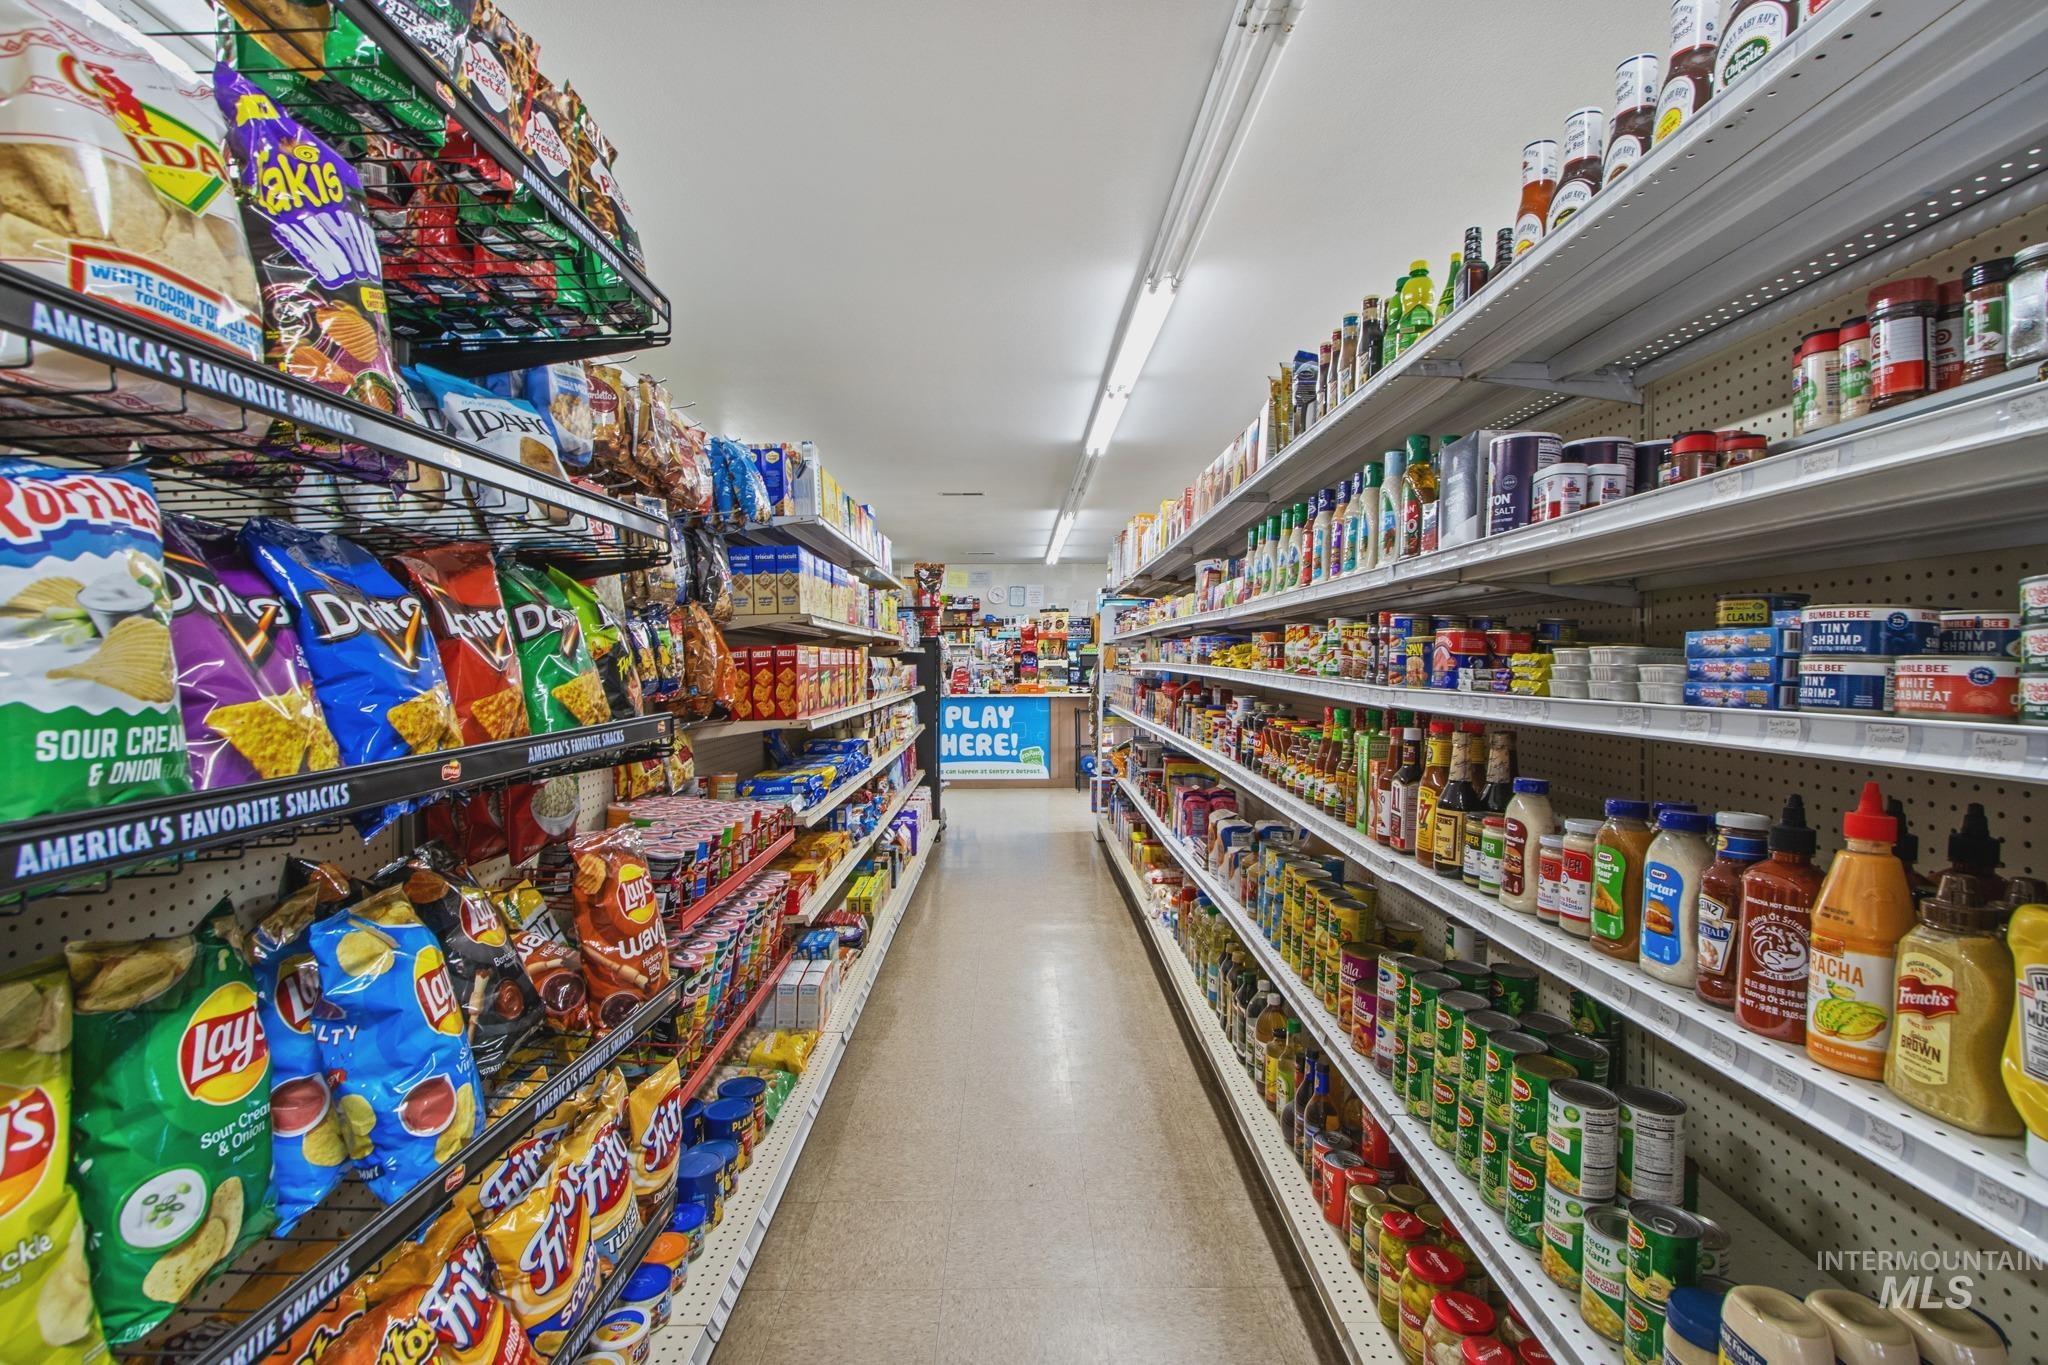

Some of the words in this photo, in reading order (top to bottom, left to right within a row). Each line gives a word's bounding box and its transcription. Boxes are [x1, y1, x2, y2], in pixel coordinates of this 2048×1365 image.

[1737, 18, 1757, 36] BABY
[1756, 13, 1780, 26] RAY'S
[471, 42, 508, 81] Dot's
[1724, 45, 1765, 80] Chipotle
[351, 73, 373, 88] NET
[373, 82, 390, 97] WT
[527, 136, 570, 169] Pretzels
[522, 164, 566, 218] AMERICA'S
[90, 264, 154, 293] WHITE
[157, 281, 196, 312] CORN
[134, 290, 188, 321] TOTOPOS
[189, 313, 204, 328] DE
[32, 300, 185, 381] AMERICA'S
[187, 356, 289, 408] FAVORITE
[291, 391, 356, 436] SNACKS
[587, 390, 617, 401] ardetto's
[1489, 492, 1512, 507] TON
[1494, 505, 1517, 516] SALT
[1726, 612, 1764, 622] CLAMS
[1808, 610, 1847, 620] BUMBLE
[1848, 610, 1871, 619] BEE
[1982, 619, 2006, 628] BEE
[1820, 623, 1851, 634] TINY
[1952, 630, 1983, 641] TINY
[1812, 635, 1863, 646] SHRIMP
[1942, 641, 1997, 652] SHRIMP
[1824, 664, 1844, 673] BEE
[1925, 664, 1949, 673] BEE
[1804, 676, 1826, 687] TINY
[1800, 688, 1836, 699] SHRIMP
[944, 705, 1015, 729] PLAY
[35, 726, 119, 764] SOUR
[527, 742, 571, 764] AMERICA'S
[571, 734, 602, 754] FAVORITE
[601, 729, 626, 749] SNACKS
[941, 732, 1018, 757] HERE!
[88, 763, 102, 788] &
[108, 757, 163, 785] ONION
[957, 768, 979, 776] happen
[14, 814, 175, 881] AMERICA'S
[180, 797, 282, 842] FAVORITE
[284, 782, 351, 818] SNACKS
[623, 874, 653, 912] Lay's
[1700, 899, 1719, 916] EINZ
[1769, 901, 1782, 910] HOT
[1783, 904, 1804, 914] CHILLI
[641, 951, 664, 970] Hickory
[647, 960, 662, 977] BBQ
[1811, 952, 1865, 989] RACHA
[1898, 985, 1951, 1007] French's
[1900, 1034, 1941, 1064] BROWN
[535, 1073, 579, 1121] AMERICA'S
[578, 1048, 610, 1082] FAVORITE
[609, 1025, 635, 1055] SNACKS
[732, 1115, 753, 1132] PLAN
[1637, 1112, 1660, 1123] Nutrition
[1661, 1116, 1676, 1124] Facts
[200, 1123, 236, 1150] Sour
[218, 1141, 230, 1158] &
[231, 1119, 266, 1149] Onion
[1637, 1130, 1657, 1139] Calories
[0, 1230, 54, 1273] ckle
[1586, 1234, 1611, 1256] reen
[281, 1259, 351, 1333] SNACKS
[1600, 1282, 1620, 1298] CORN
[1601, 1278, 1620, 1292] STYLE
